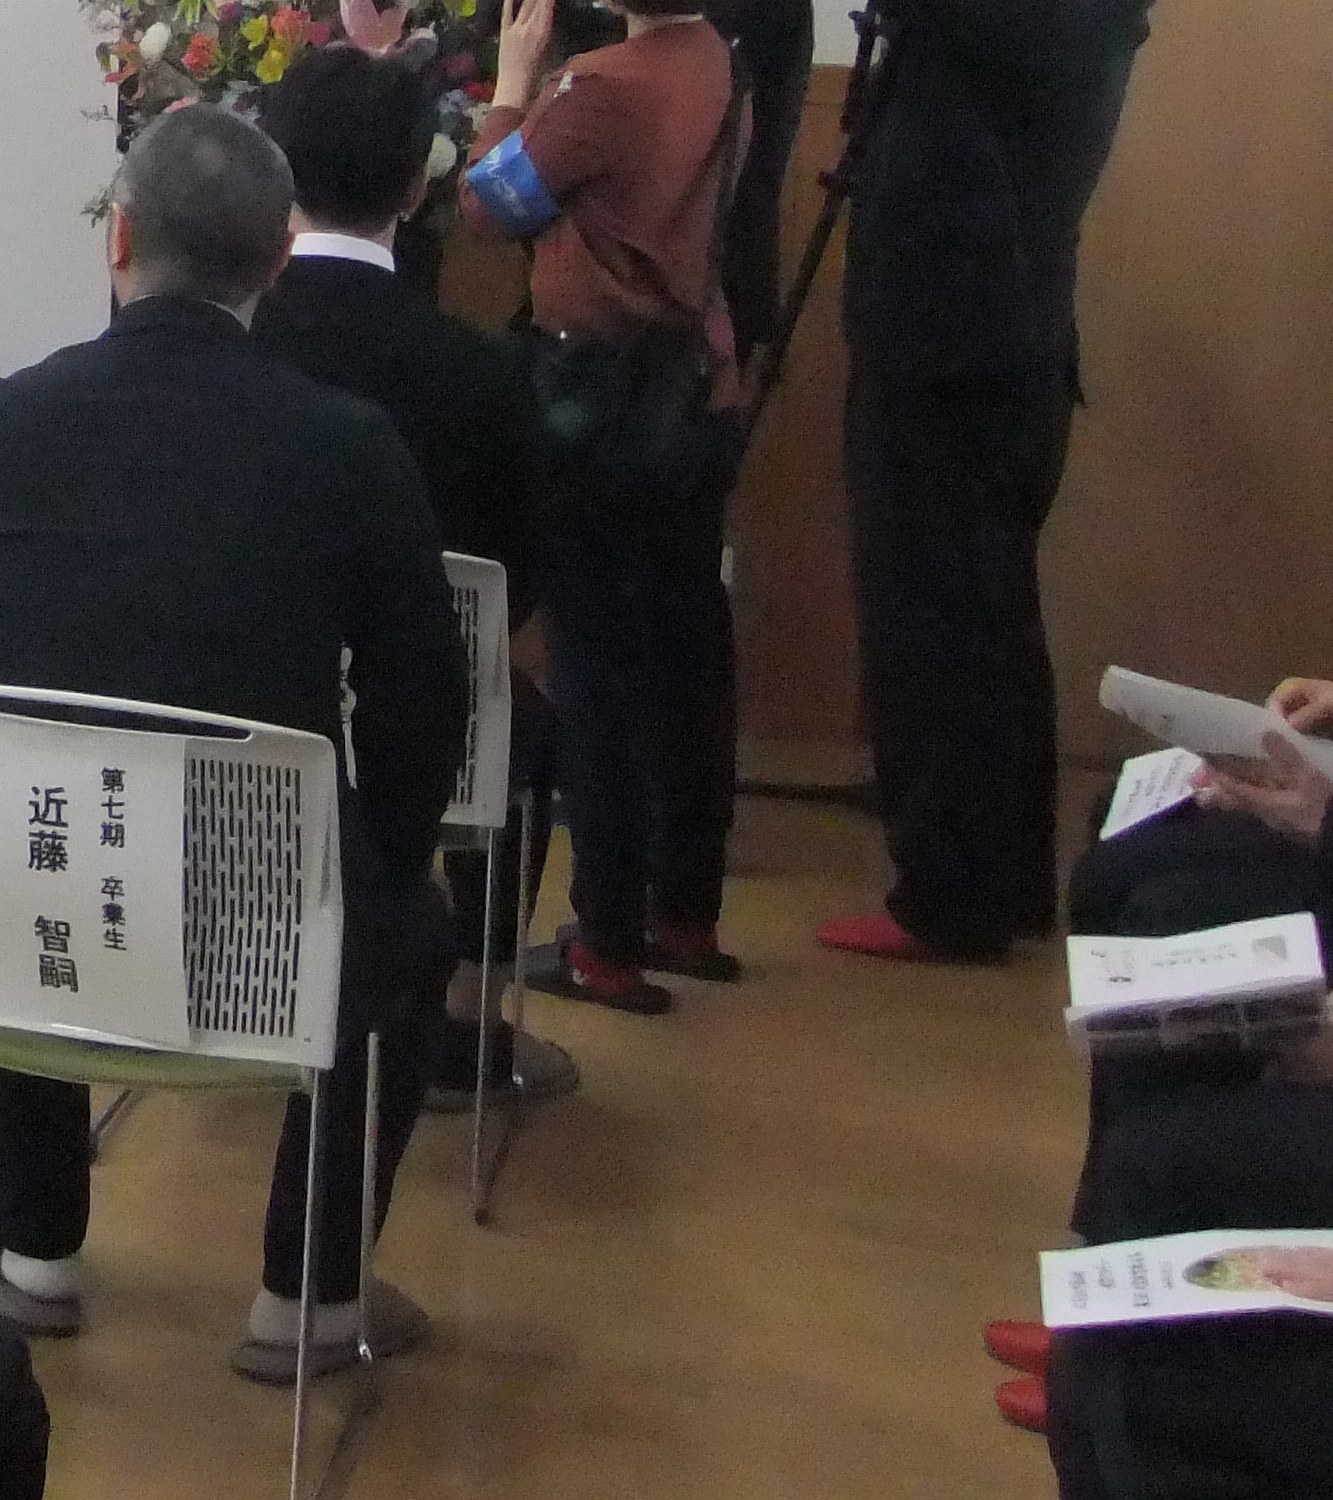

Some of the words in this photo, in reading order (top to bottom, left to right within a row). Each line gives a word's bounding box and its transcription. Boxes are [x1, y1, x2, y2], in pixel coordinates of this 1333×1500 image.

[28, 786, 68, 873] 近藤
[99, 766, 126, 849] 第七期
[34, 914, 79, 994] 智嗣
[100, 875, 127, 952] 卒業生
